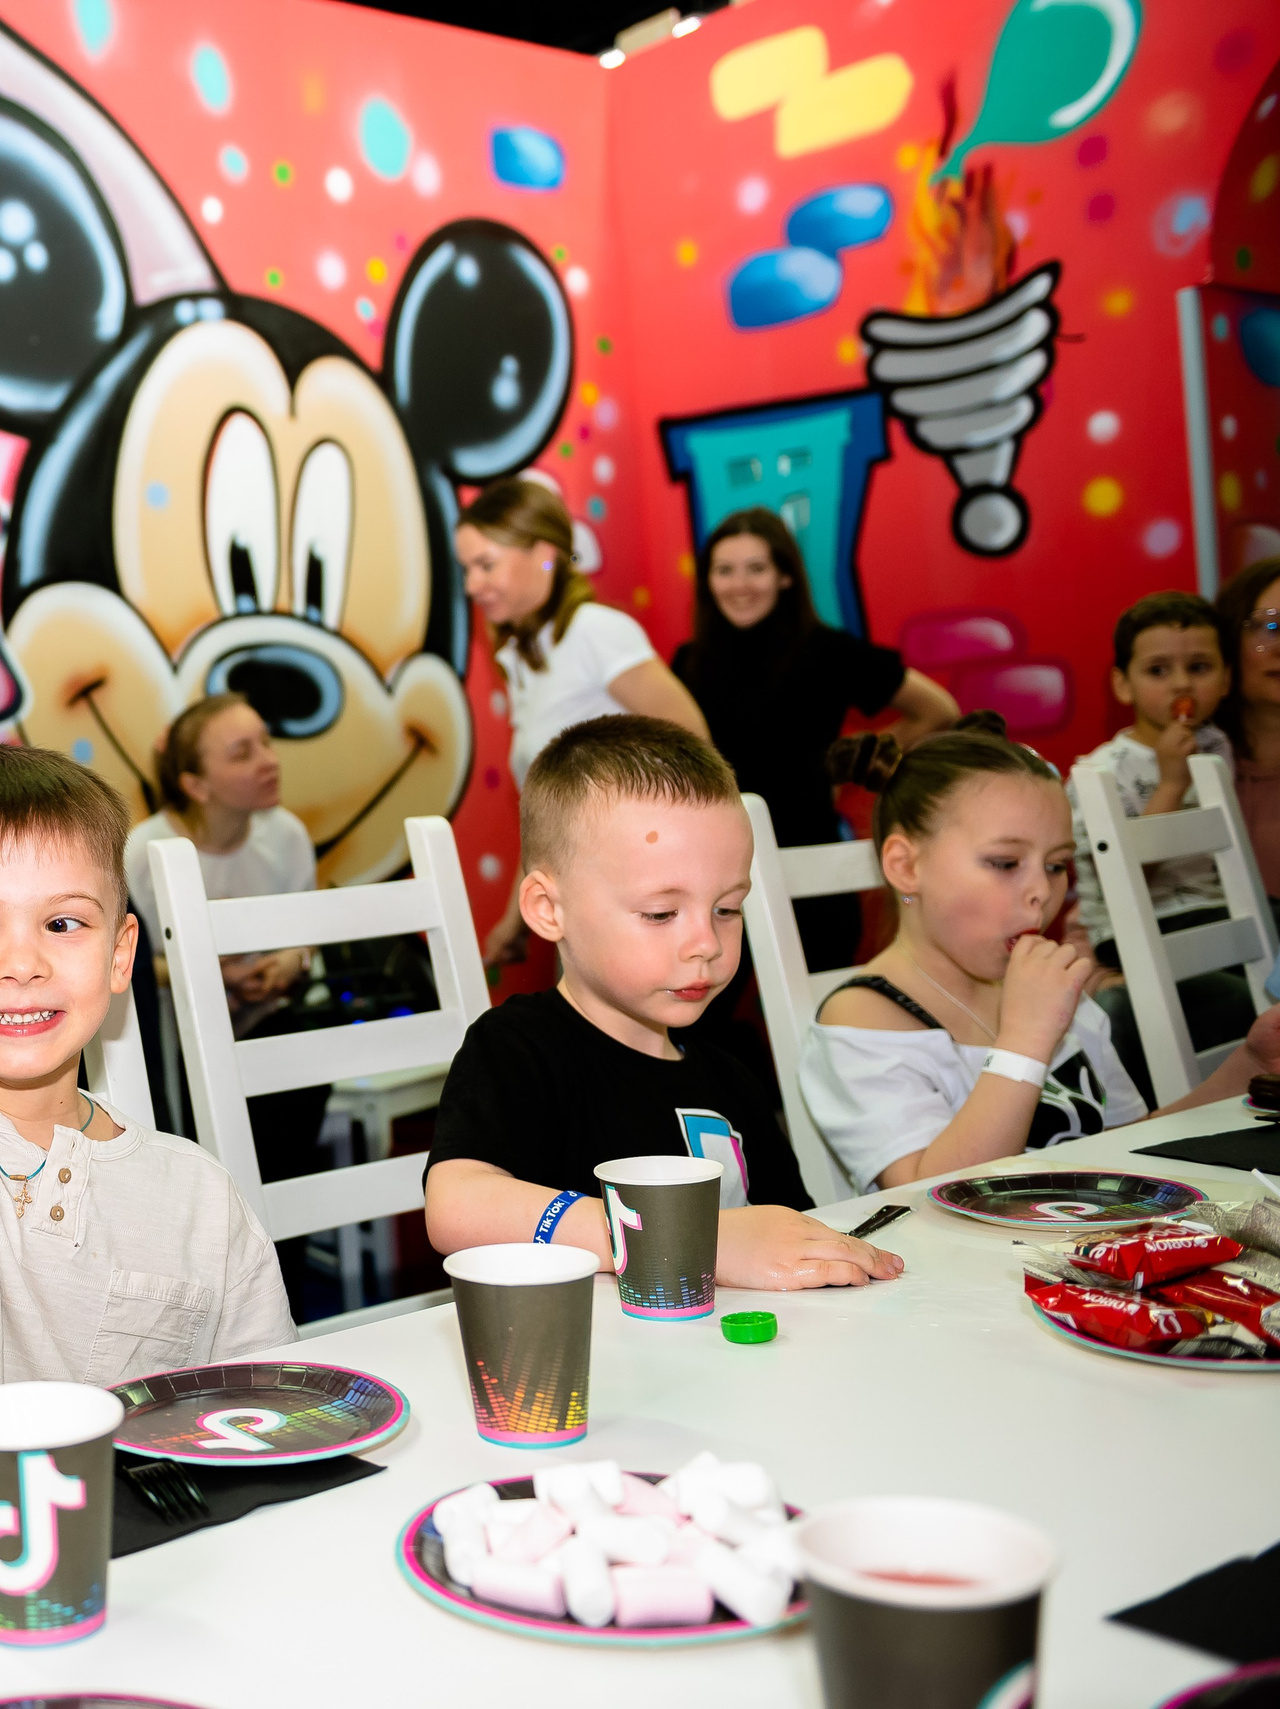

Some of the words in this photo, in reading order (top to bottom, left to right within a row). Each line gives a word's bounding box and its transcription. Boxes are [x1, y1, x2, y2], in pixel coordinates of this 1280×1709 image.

[539, 1201, 565, 1233] TikTok
[1144, 1240, 1191, 1252] ORION
[1081, 1292, 1125, 1310] ORION
